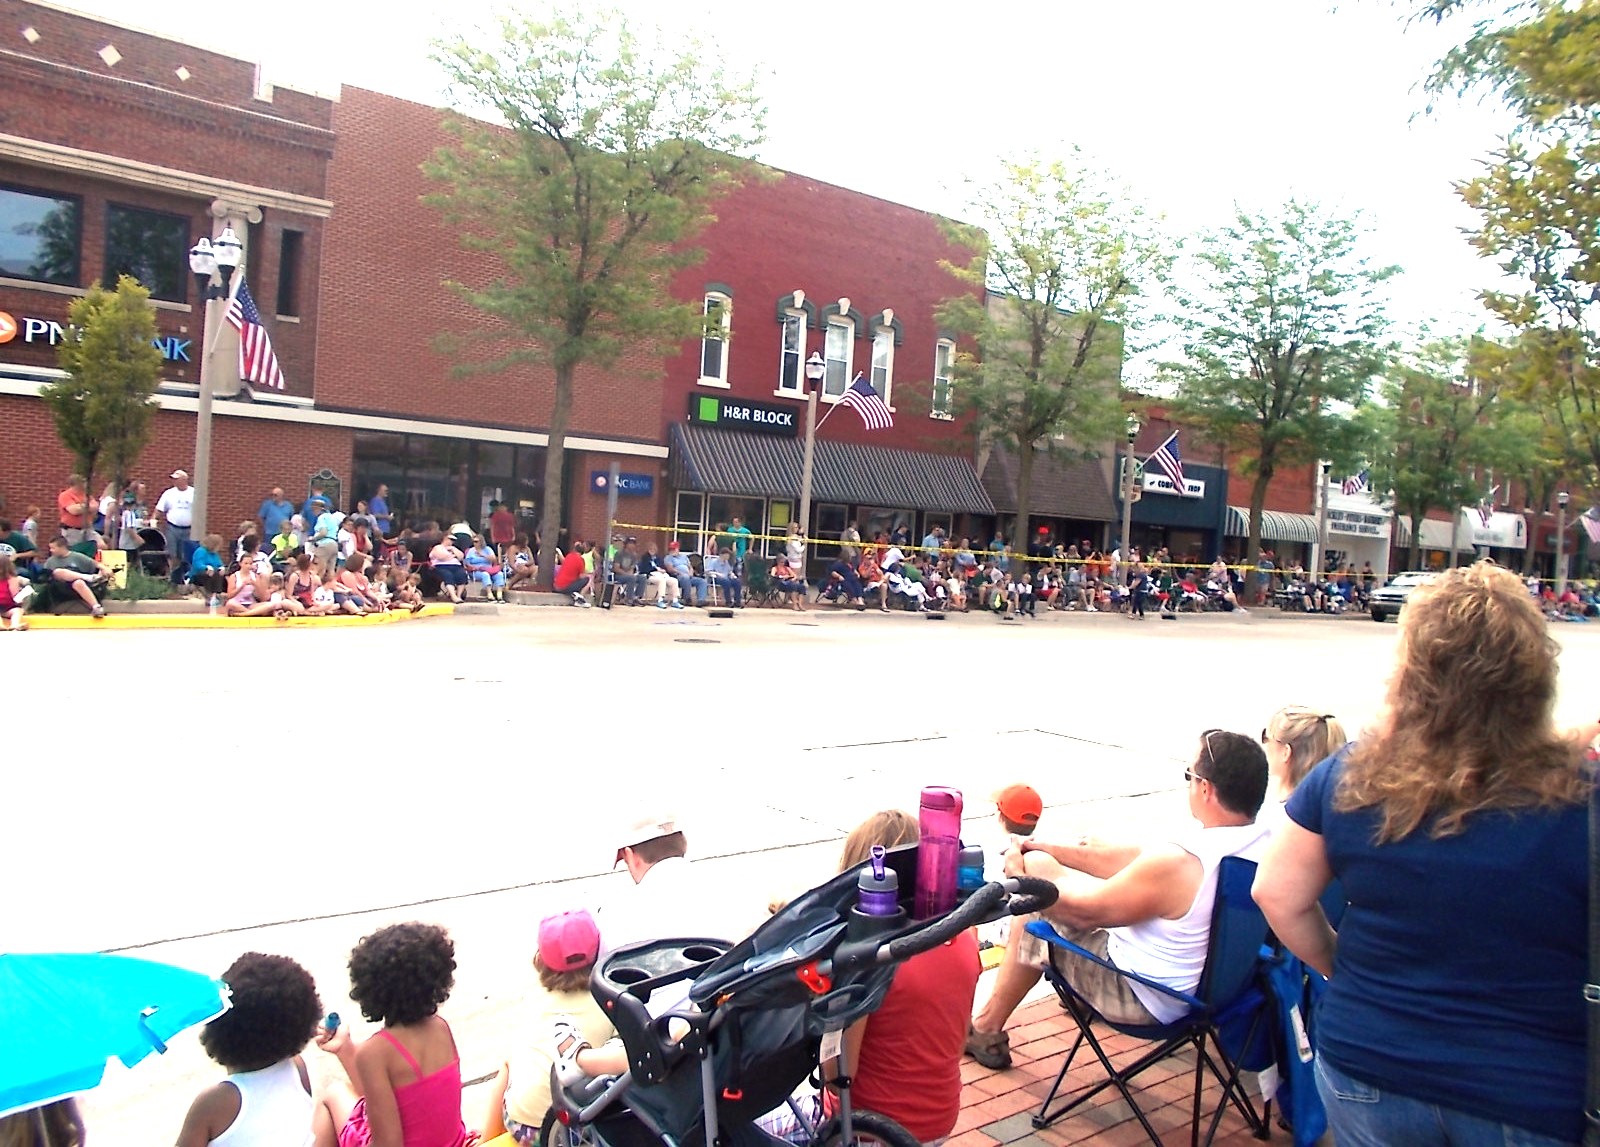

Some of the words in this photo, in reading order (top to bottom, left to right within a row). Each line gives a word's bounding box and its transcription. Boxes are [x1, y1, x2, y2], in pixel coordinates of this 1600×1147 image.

[723, 405, 750, 420] H&R
[753, 409, 793, 426] BLOCK
[629, 479, 650, 490] BANK
